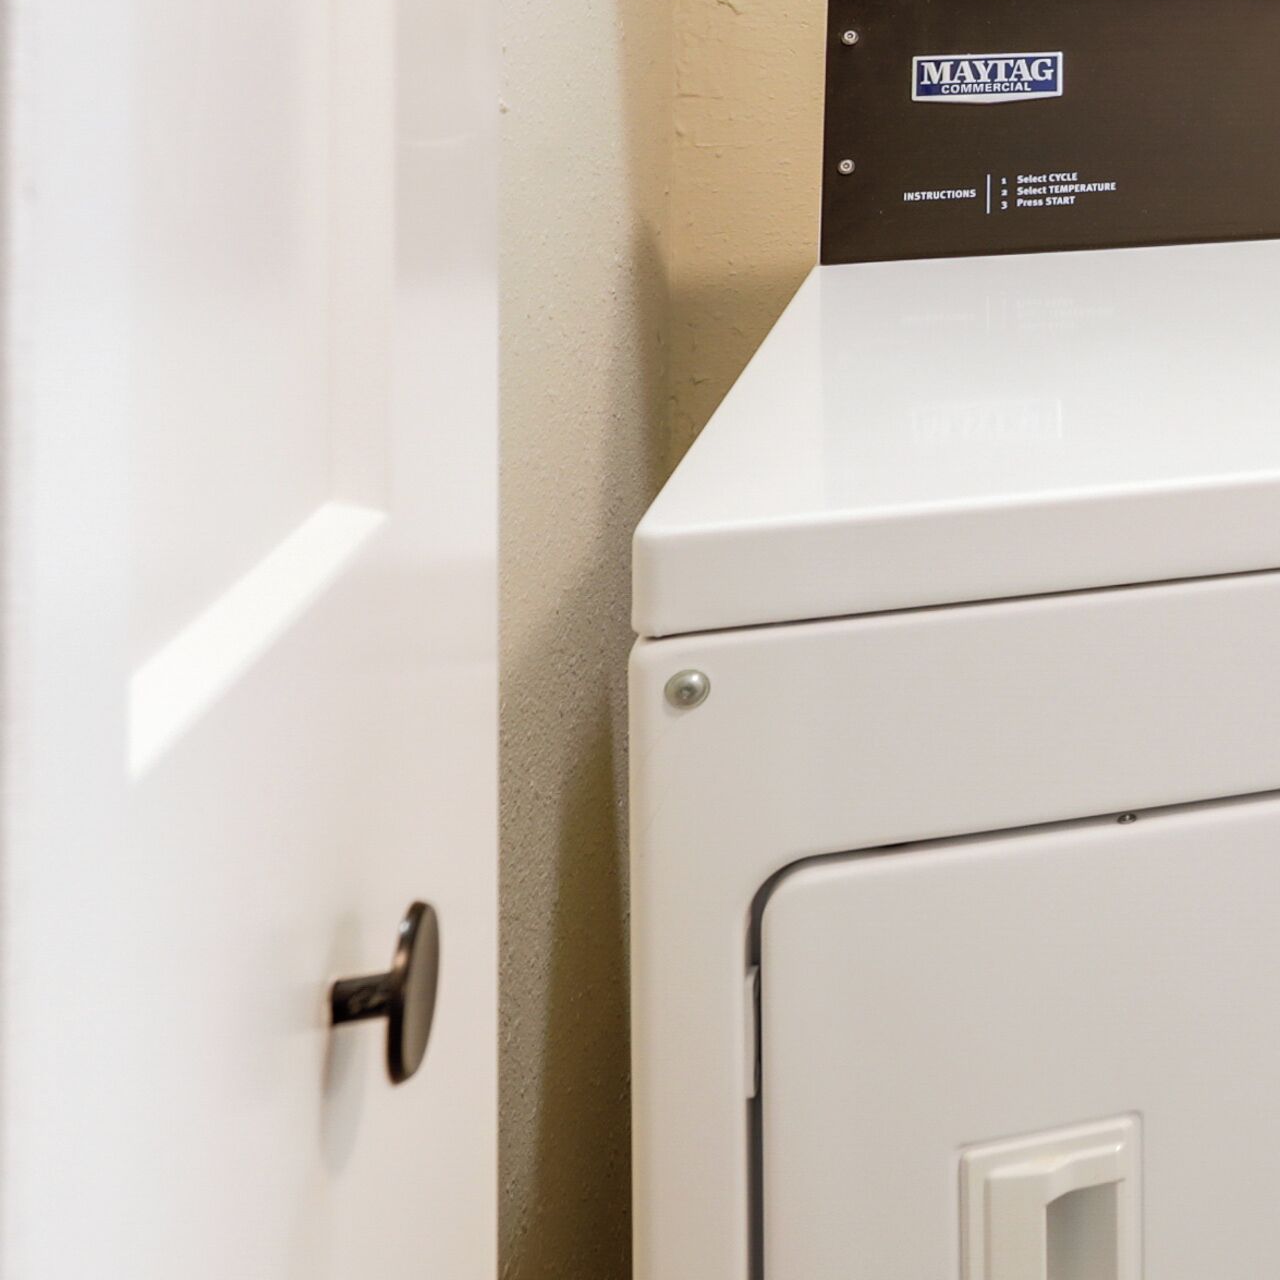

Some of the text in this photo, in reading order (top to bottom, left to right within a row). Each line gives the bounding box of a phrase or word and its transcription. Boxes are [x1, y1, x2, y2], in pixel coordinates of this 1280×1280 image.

[919, 58, 1054, 85] MAYTAG
[941, 81, 1032, 94] COMMERCIAL
[1016, 173, 1047, 184] Select
[1048, 172, 1078, 182] CYCLE
[903, 188, 977, 202] INSTRUCTIONS
[1016, 185, 1047, 196] Select
[1049, 182, 1117, 194] TEMPERATURE
[1001, 195, 1076, 210] 3 Press START
